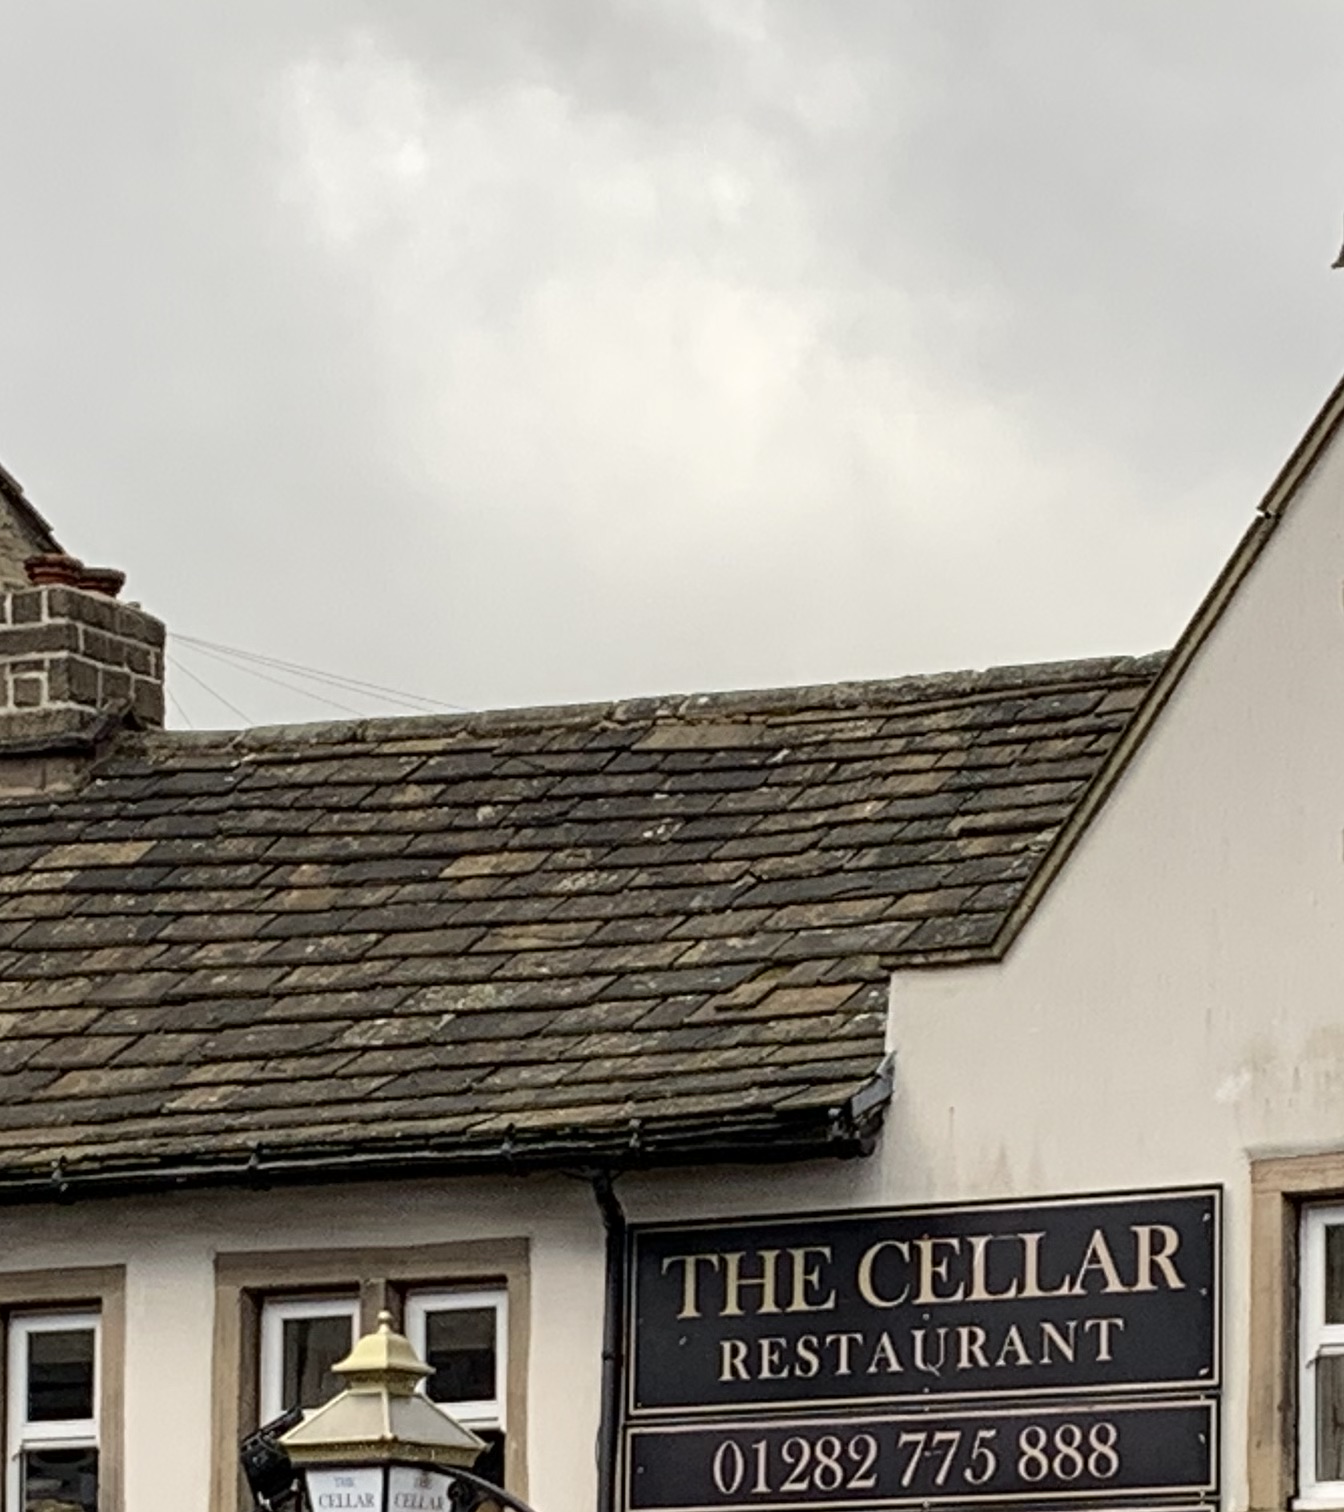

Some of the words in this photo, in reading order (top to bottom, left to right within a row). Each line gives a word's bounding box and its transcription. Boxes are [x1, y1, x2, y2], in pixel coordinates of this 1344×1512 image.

[661, 1245, 837, 1320] THE
[857, 1224, 1186, 1310] CELLAR
[717, 1318, 1126, 1383] RESTAURANT
[712, 1434, 879, 1494] 01282
[897, 1429, 997, 1488] 775
[1017, 1422, 1119, 1482] 888
[319, 1493, 375, 1509] CELLAR
